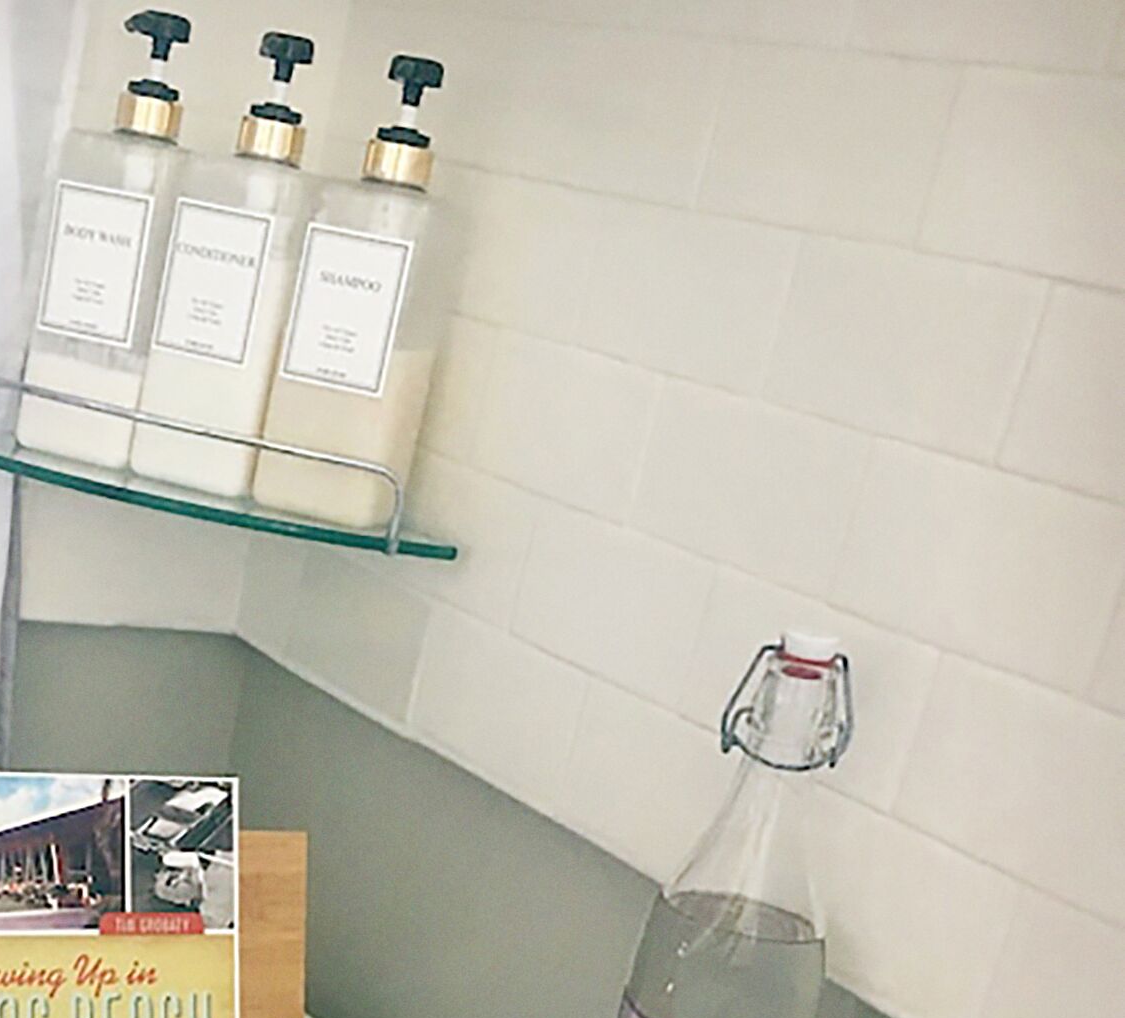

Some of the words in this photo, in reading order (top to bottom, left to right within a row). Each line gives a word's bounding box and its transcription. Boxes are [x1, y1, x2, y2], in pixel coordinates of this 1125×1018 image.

[62, 222, 95, 241] BODY
[175, 241, 256, 268] CONDITIONER
[319, 270, 382, 293] SHAMPOO
[72, 953, 119, 998] Up
[126, 960, 158, 985] in
